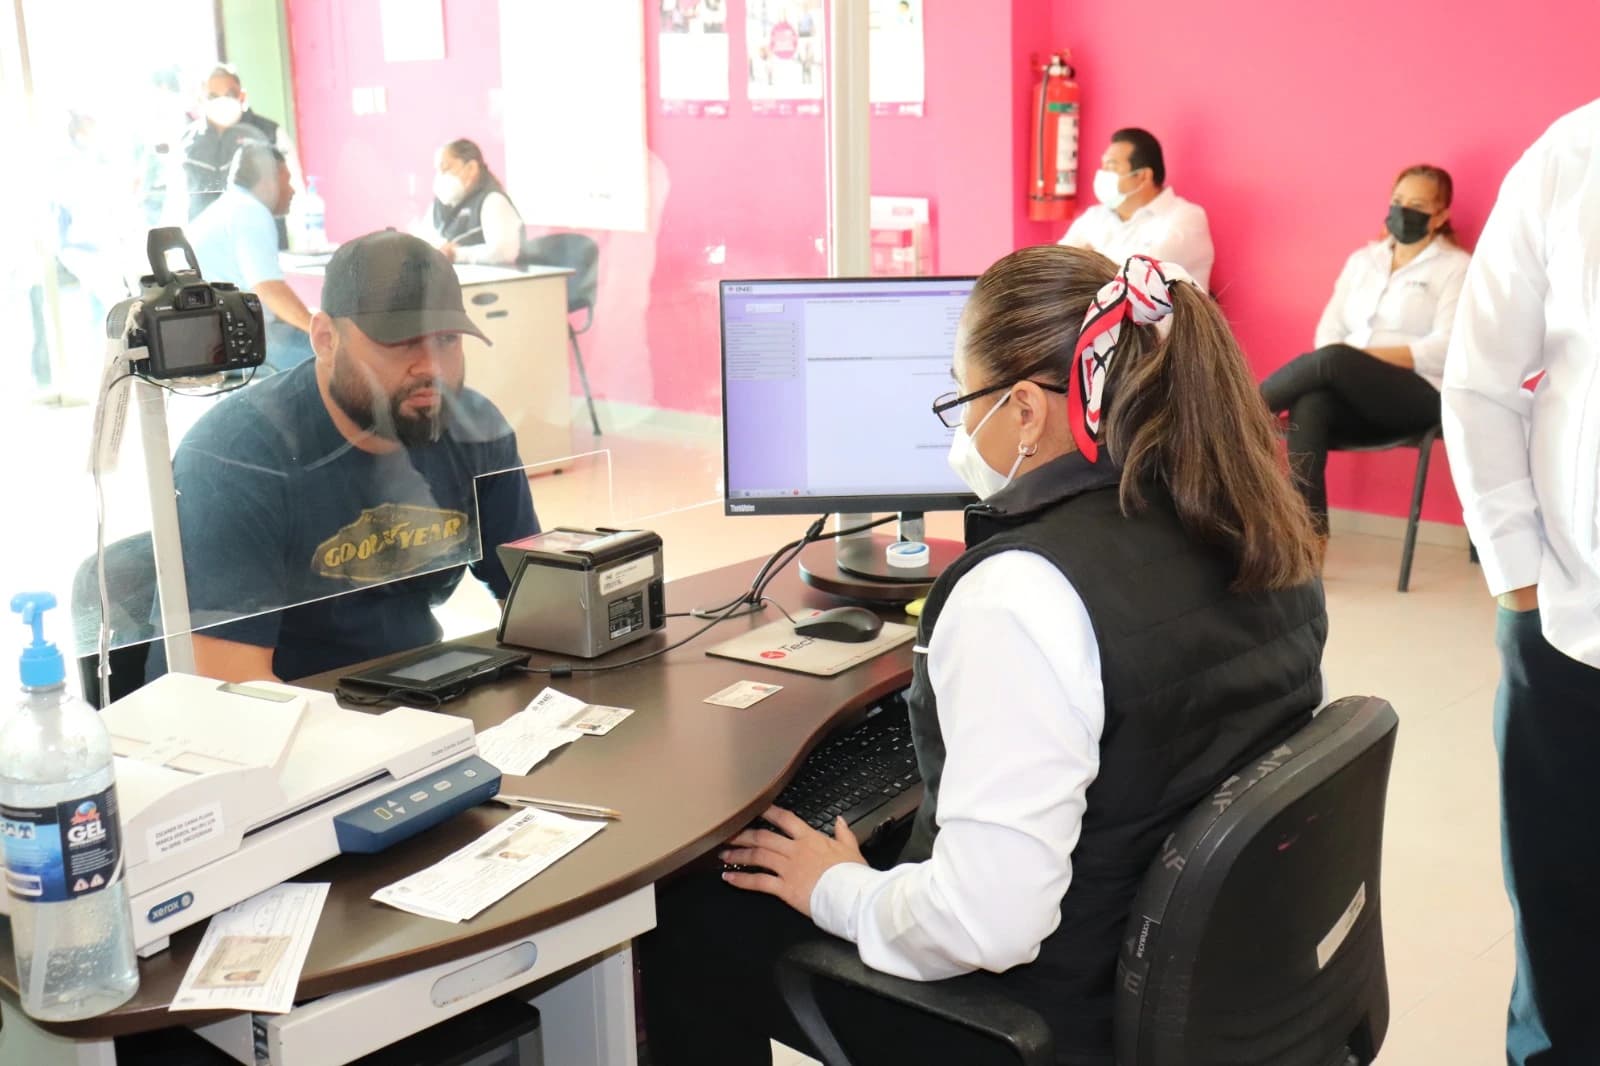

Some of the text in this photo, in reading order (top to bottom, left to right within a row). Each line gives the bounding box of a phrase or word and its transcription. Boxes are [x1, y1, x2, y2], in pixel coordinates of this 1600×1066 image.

[514, 813, 536, 827] INE
[67, 819, 107, 843] GEL
[152, 901, 179, 919] xerox
